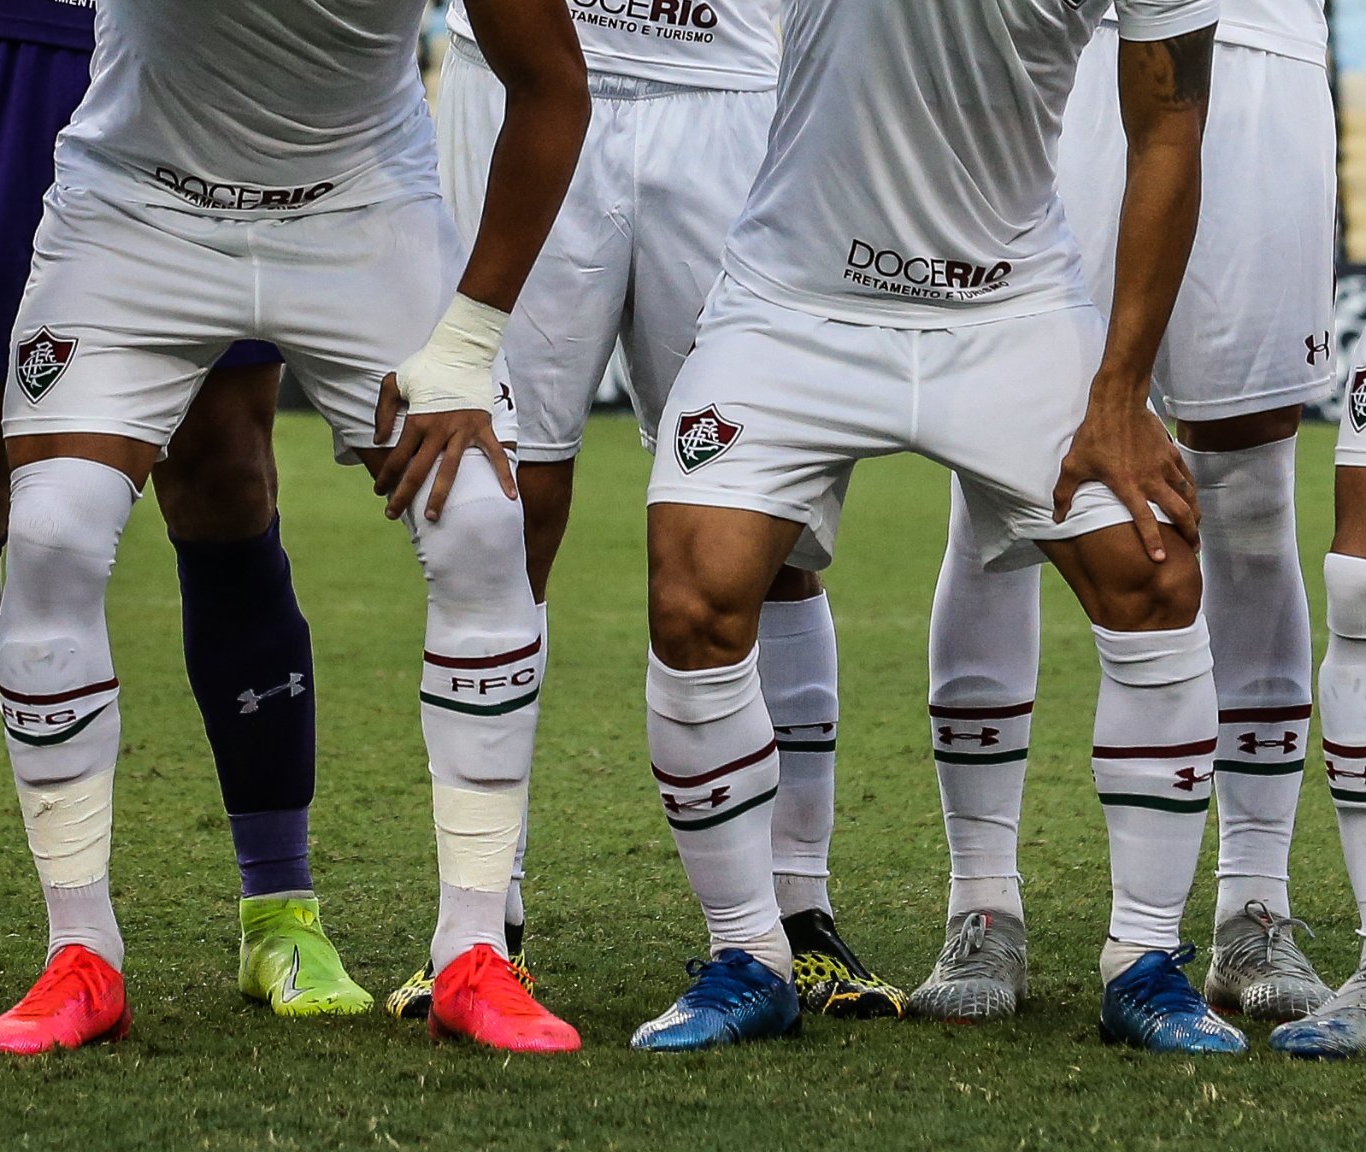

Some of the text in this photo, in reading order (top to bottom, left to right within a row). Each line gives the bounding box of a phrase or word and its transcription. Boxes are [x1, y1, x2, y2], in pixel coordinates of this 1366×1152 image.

[570, 9, 714, 44] TAMENTO E TURISMO
[847, 238, 1013, 289] DOCERIO
[843, 268, 942, 299] FRETAMENTO
[956, 279, 1010, 301] TURISMO
[452, 667, 535, 695] FFC
[1, 702, 77, 726] FFC
